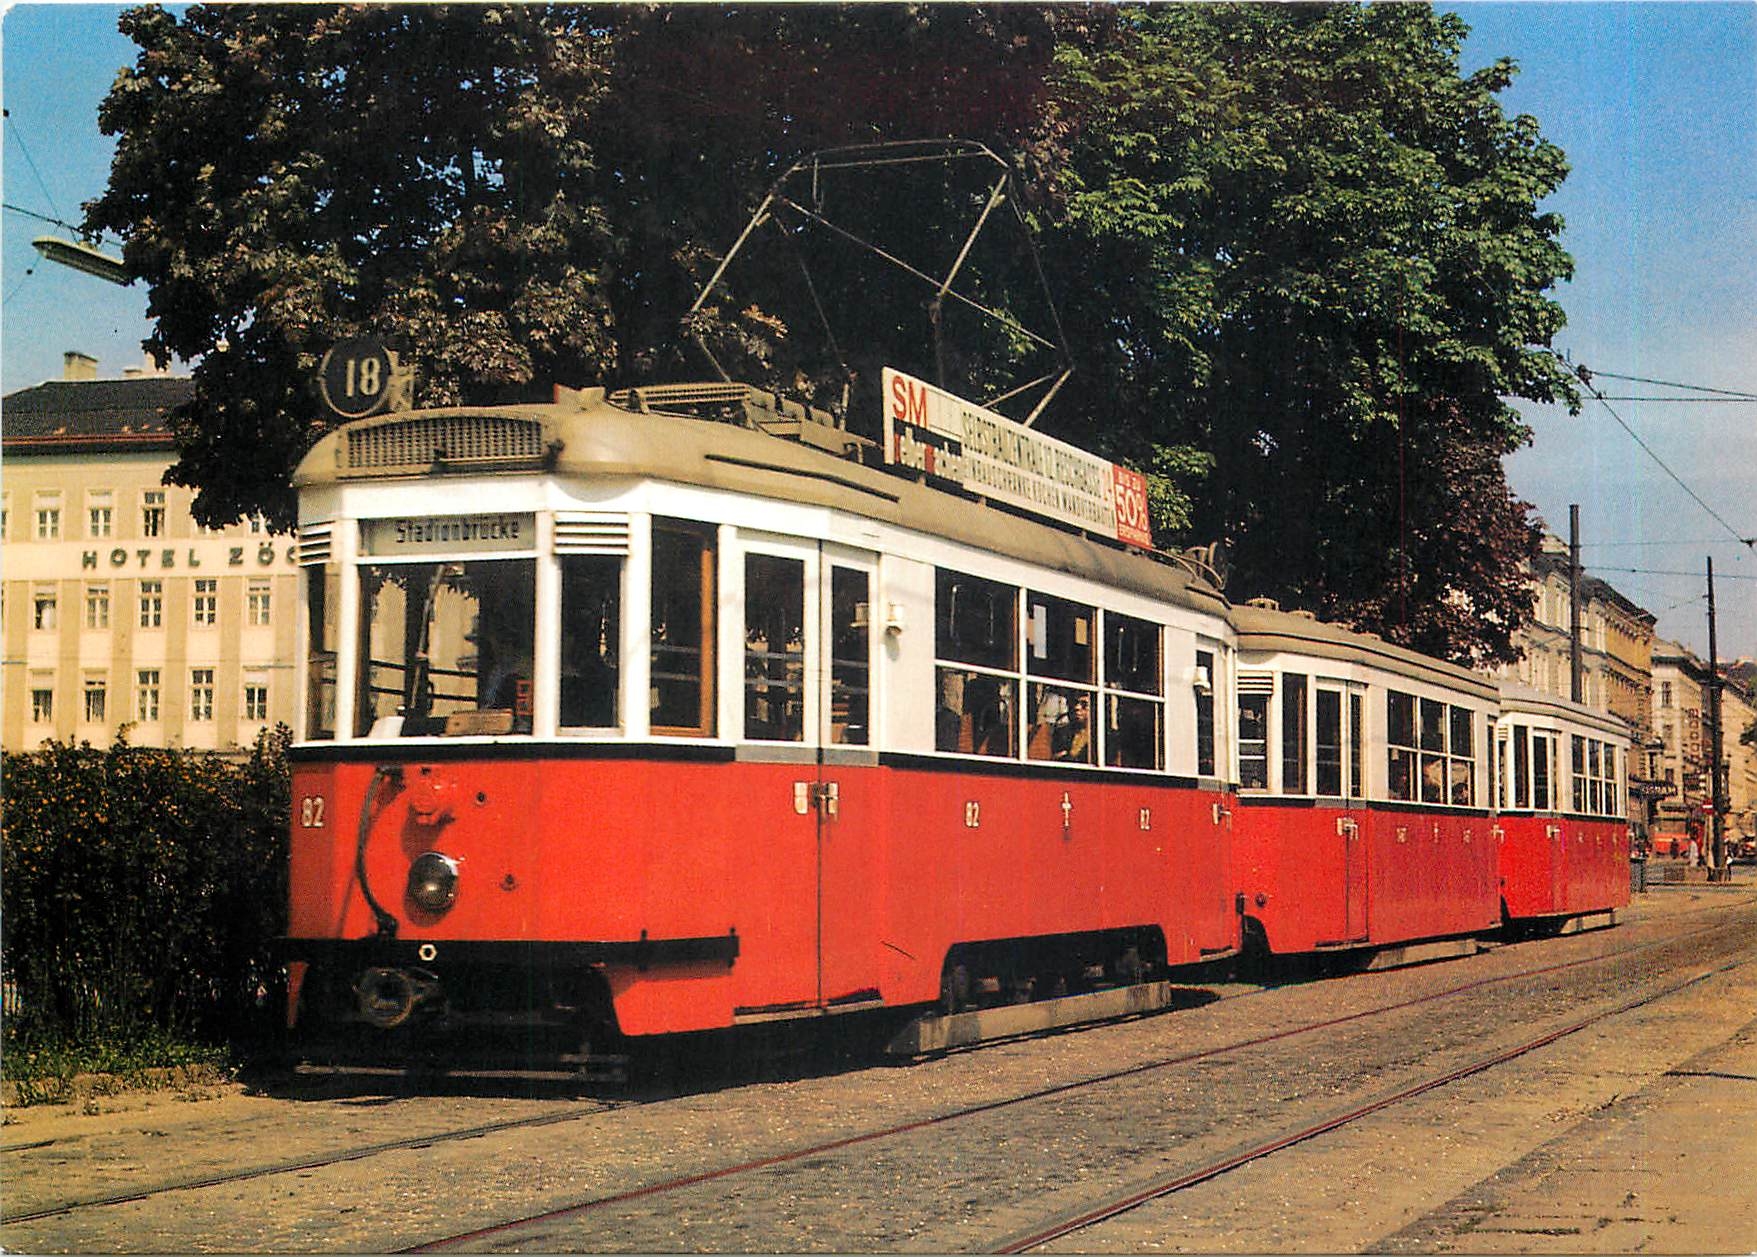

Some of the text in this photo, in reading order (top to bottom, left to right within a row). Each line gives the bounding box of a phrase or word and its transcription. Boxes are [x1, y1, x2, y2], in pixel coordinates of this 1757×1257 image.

[346, 358, 380, 397] 18
[892, 375, 928, 430] SM
[1115, 484, 1148, 532] 50%
[81, 548, 200, 570] HOTEL
[302, 797, 325, 828] 82
